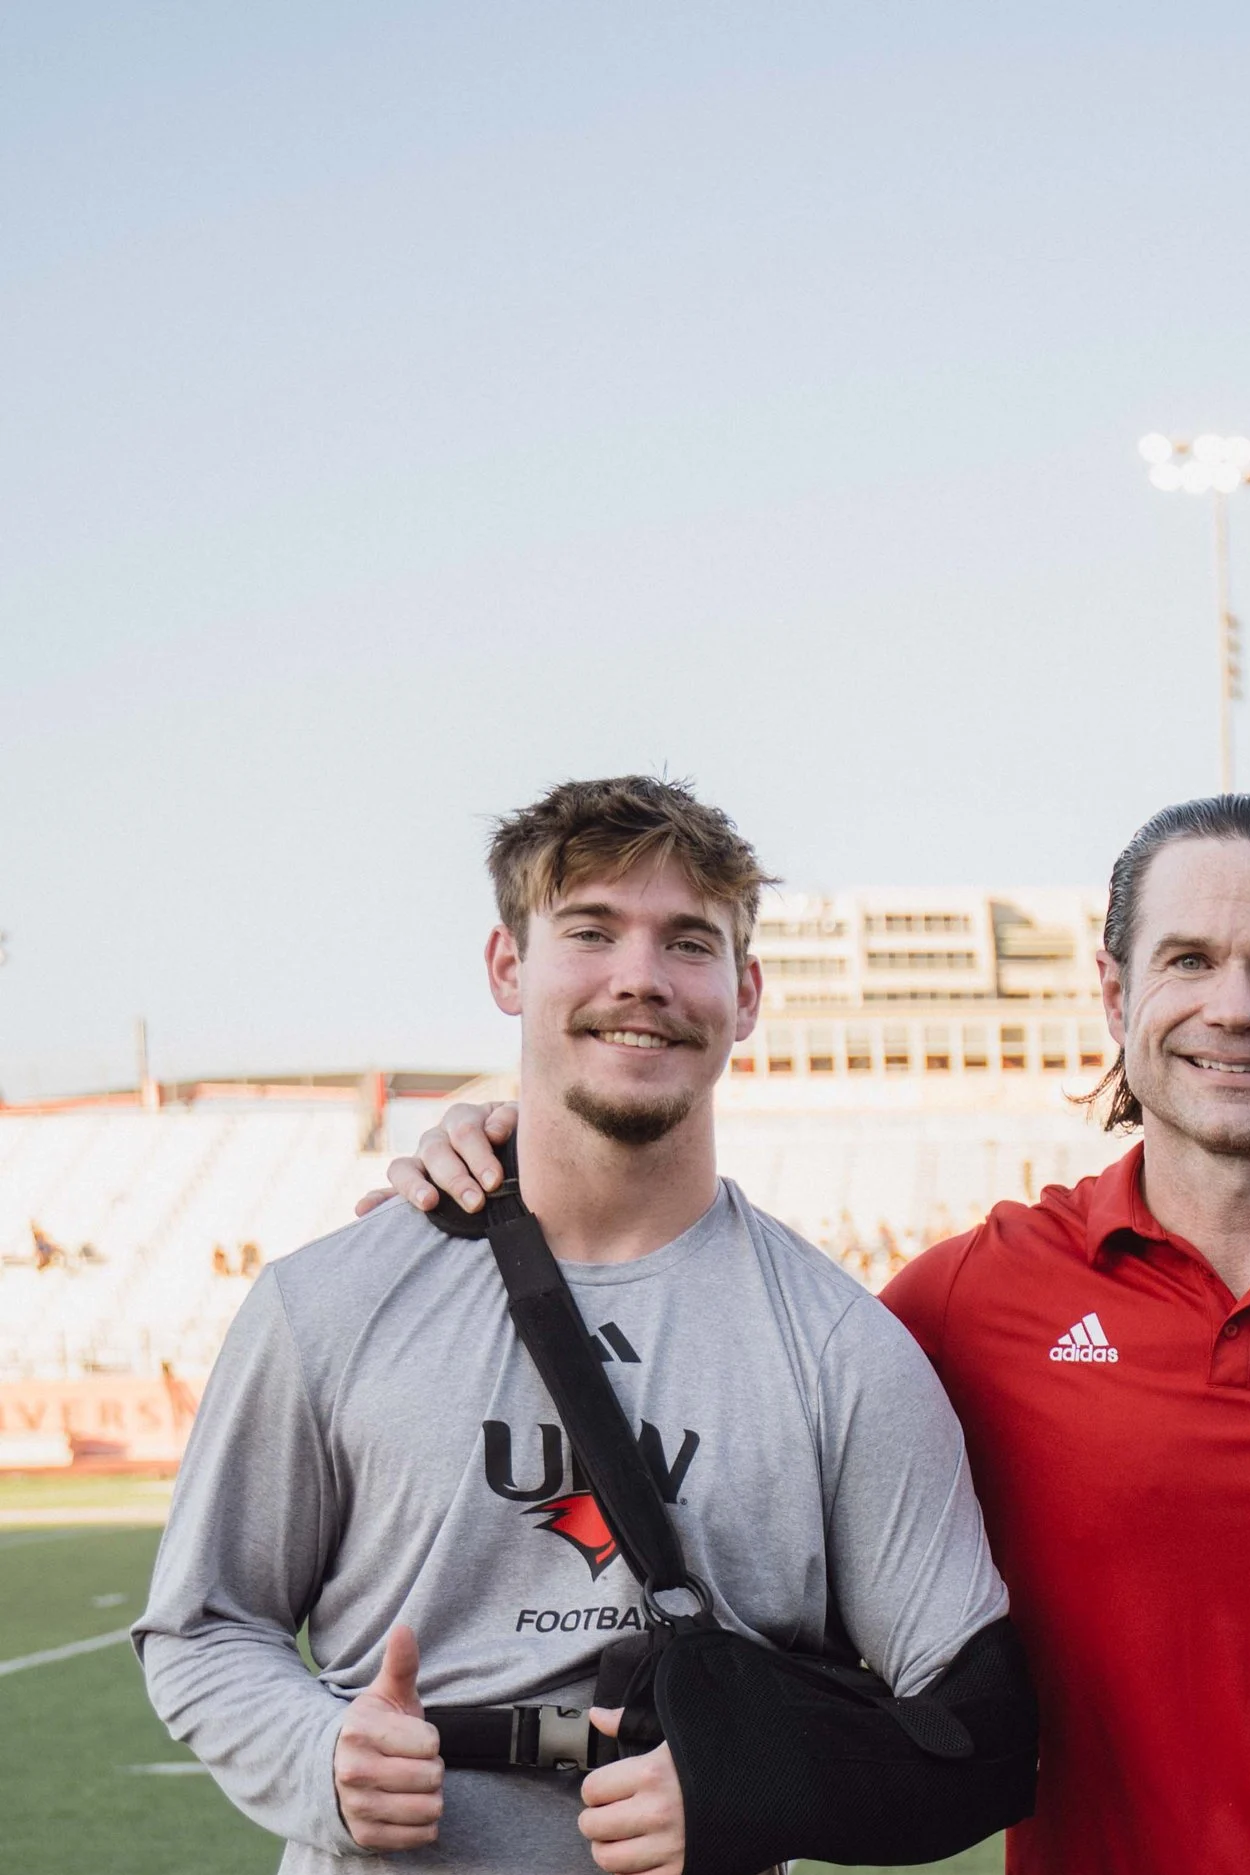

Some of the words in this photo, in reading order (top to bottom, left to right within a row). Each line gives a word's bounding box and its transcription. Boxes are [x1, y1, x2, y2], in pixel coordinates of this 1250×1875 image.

[1049, 1344, 1119, 1363] adidas
[482, 1418, 701, 1504] UW
[515, 1606, 650, 1633] FOOTBA
